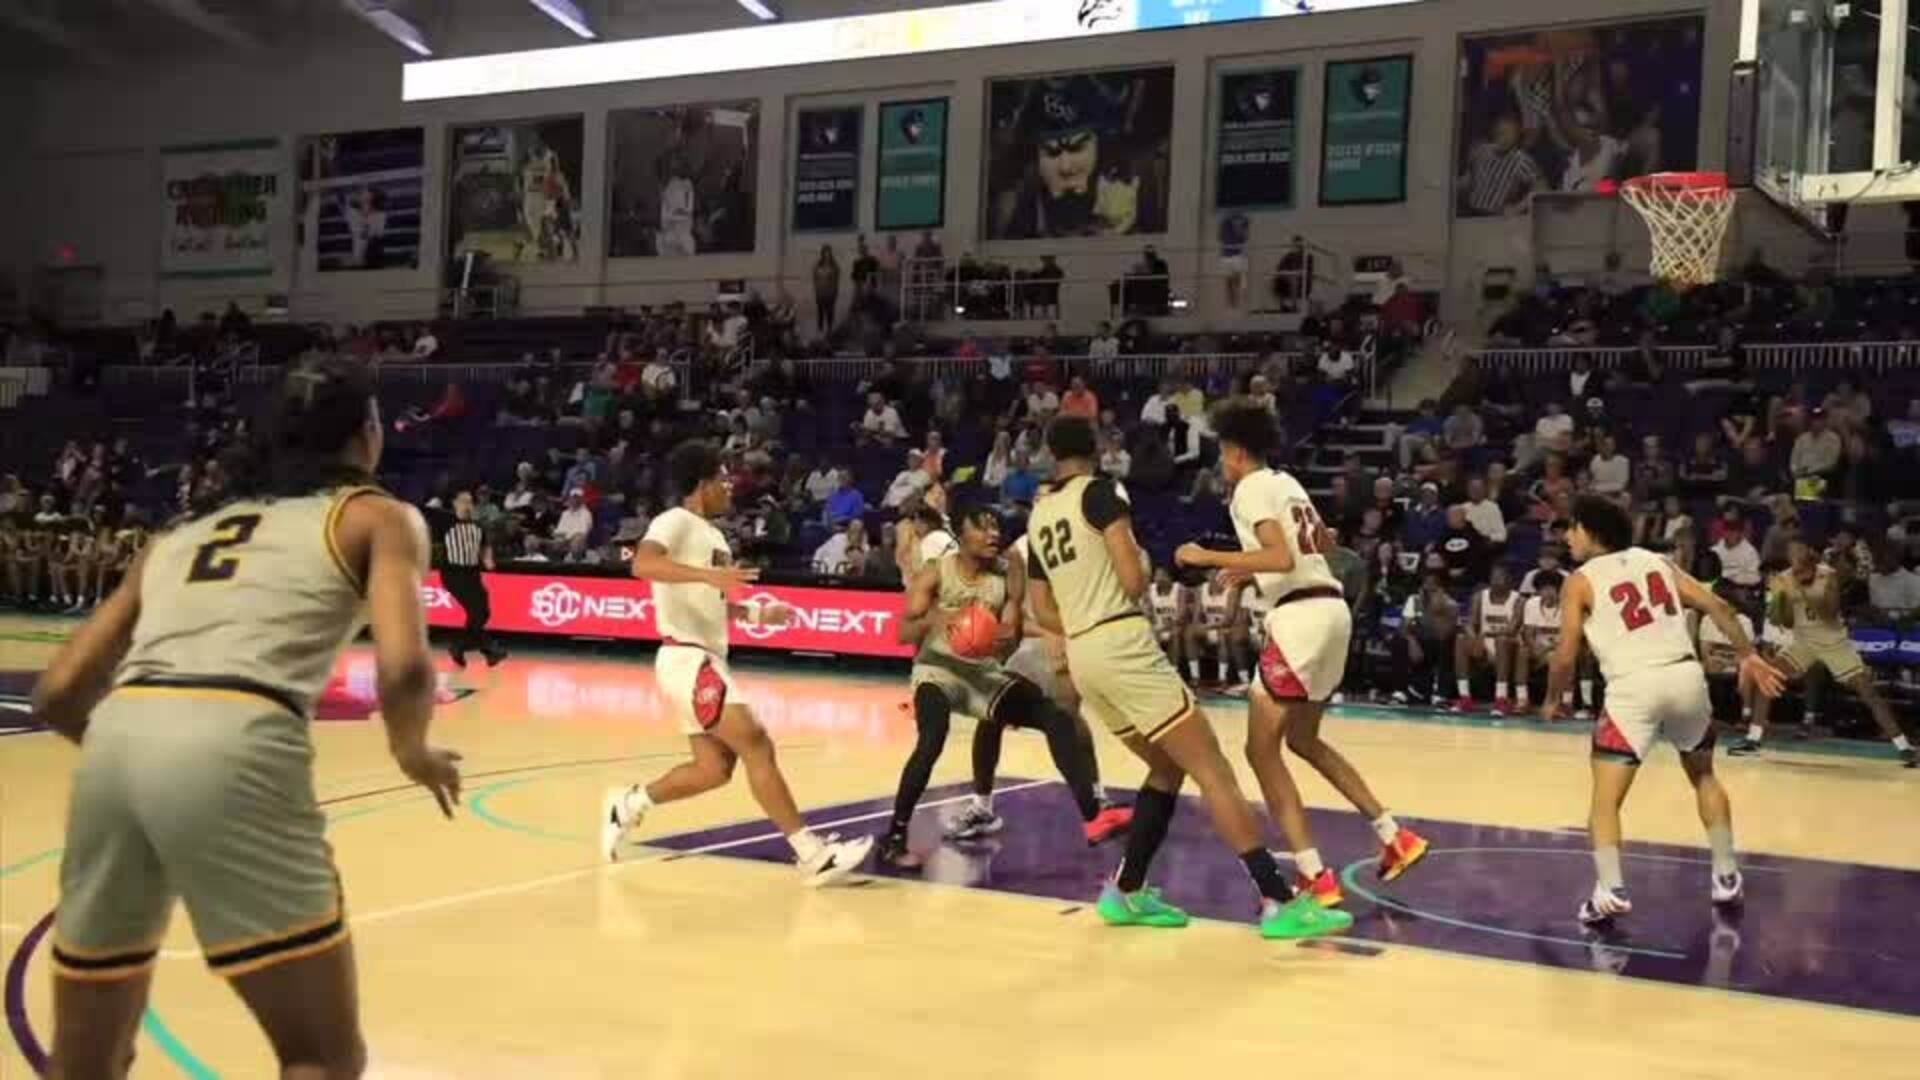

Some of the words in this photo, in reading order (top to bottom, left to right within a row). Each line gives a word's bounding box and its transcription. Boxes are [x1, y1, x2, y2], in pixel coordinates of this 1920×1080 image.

[185, 513, 262, 583] 2
[1038, 518, 1077, 570] 22
[421, 586, 454, 608] EX
[793, 606, 893, 635] NEXT
[1609, 570, 1678, 632] 24
